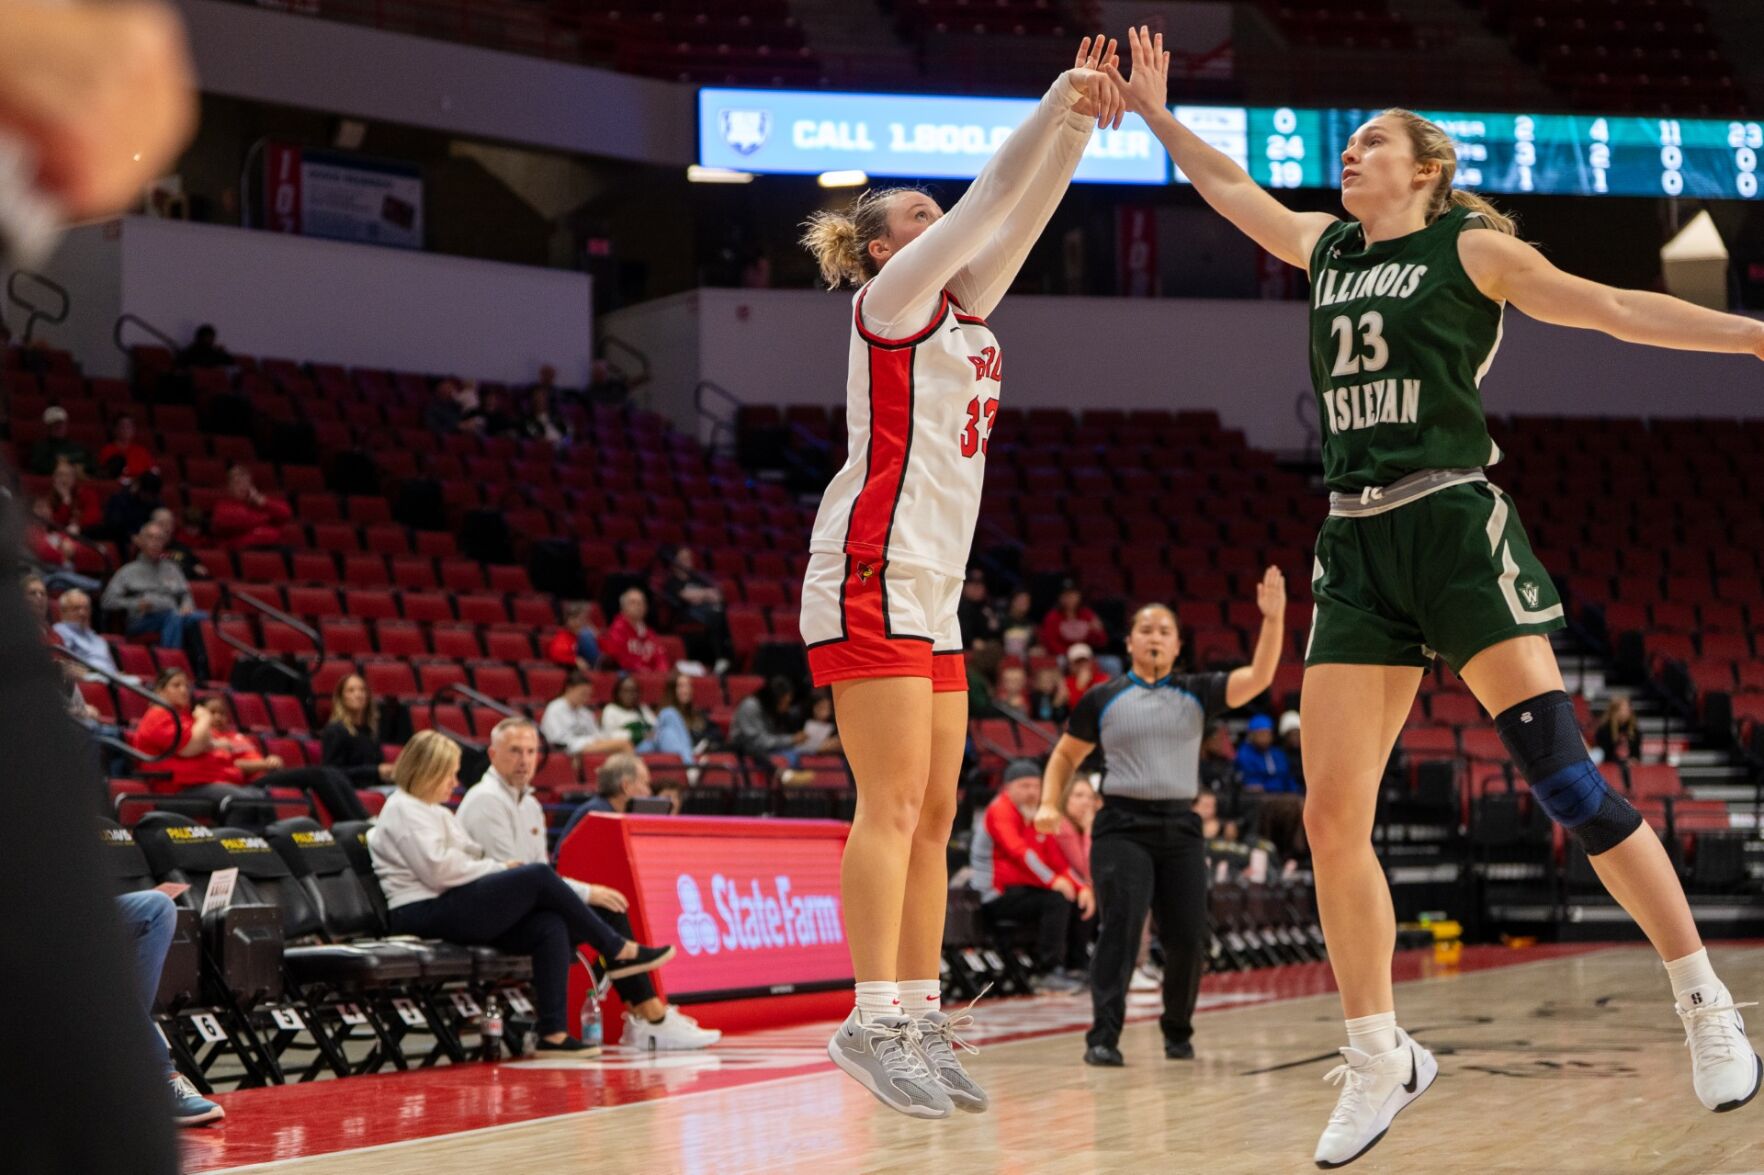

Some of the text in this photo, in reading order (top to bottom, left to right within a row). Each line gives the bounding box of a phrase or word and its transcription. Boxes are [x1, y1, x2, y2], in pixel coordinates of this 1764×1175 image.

[1273, 107, 1297, 134] 0
[1514, 115, 1535, 141] 2
[1589, 117, 1609, 144] 4
[1659, 119, 1682, 146] 11
[1727, 121, 1763, 149] 23
[792, 121, 876, 151] CALL
[1266, 134, 1305, 160] 24
[1515, 141, 1536, 166] 3
[1589, 142, 1610, 168] 2
[1660, 145, 1683, 170] 0
[1735, 147, 1757, 172] 0
[1517, 166, 1534, 191] 1
[1592, 167, 1609, 193] 1
[1661, 169, 1684, 196] 0
[1736, 172, 1758, 198] 0
[1314, 263, 1428, 310] ILLINOIS
[1331, 310, 1389, 377] 23
[201, 1016, 217, 1037] 6
[279, 1008, 294, 1026] 5
